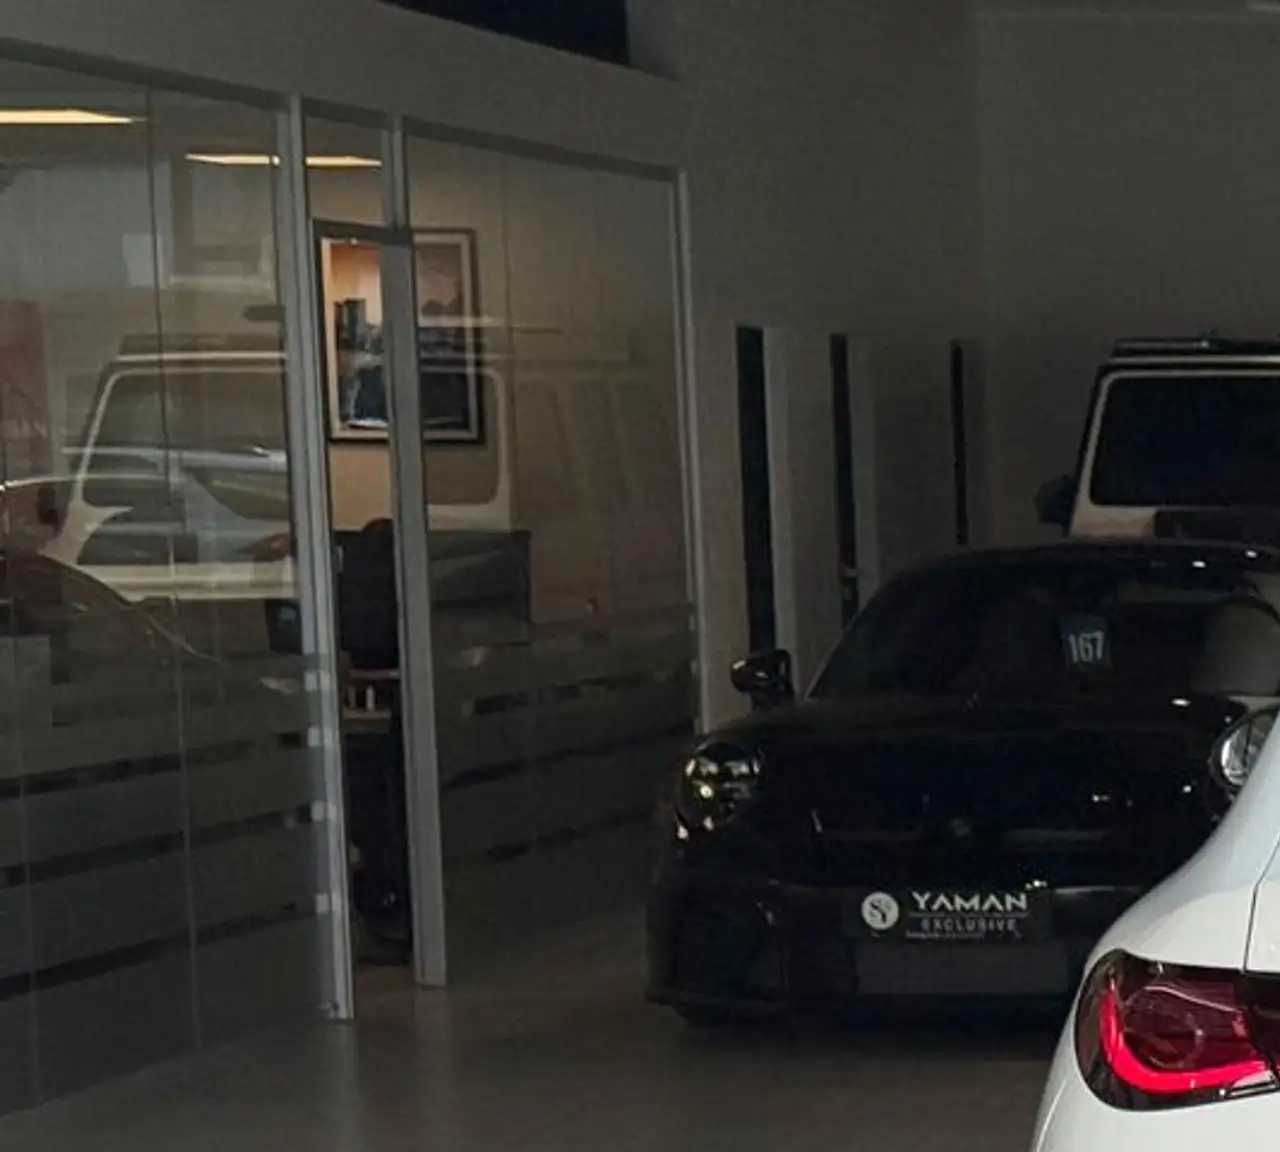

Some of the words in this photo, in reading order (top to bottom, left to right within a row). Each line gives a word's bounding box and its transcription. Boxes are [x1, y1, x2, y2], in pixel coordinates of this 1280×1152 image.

[1069, 632, 1103, 663] 167
[912, 891, 1027, 911] YAMAN
[921, 919, 1017, 931] EXCLUSIVE
